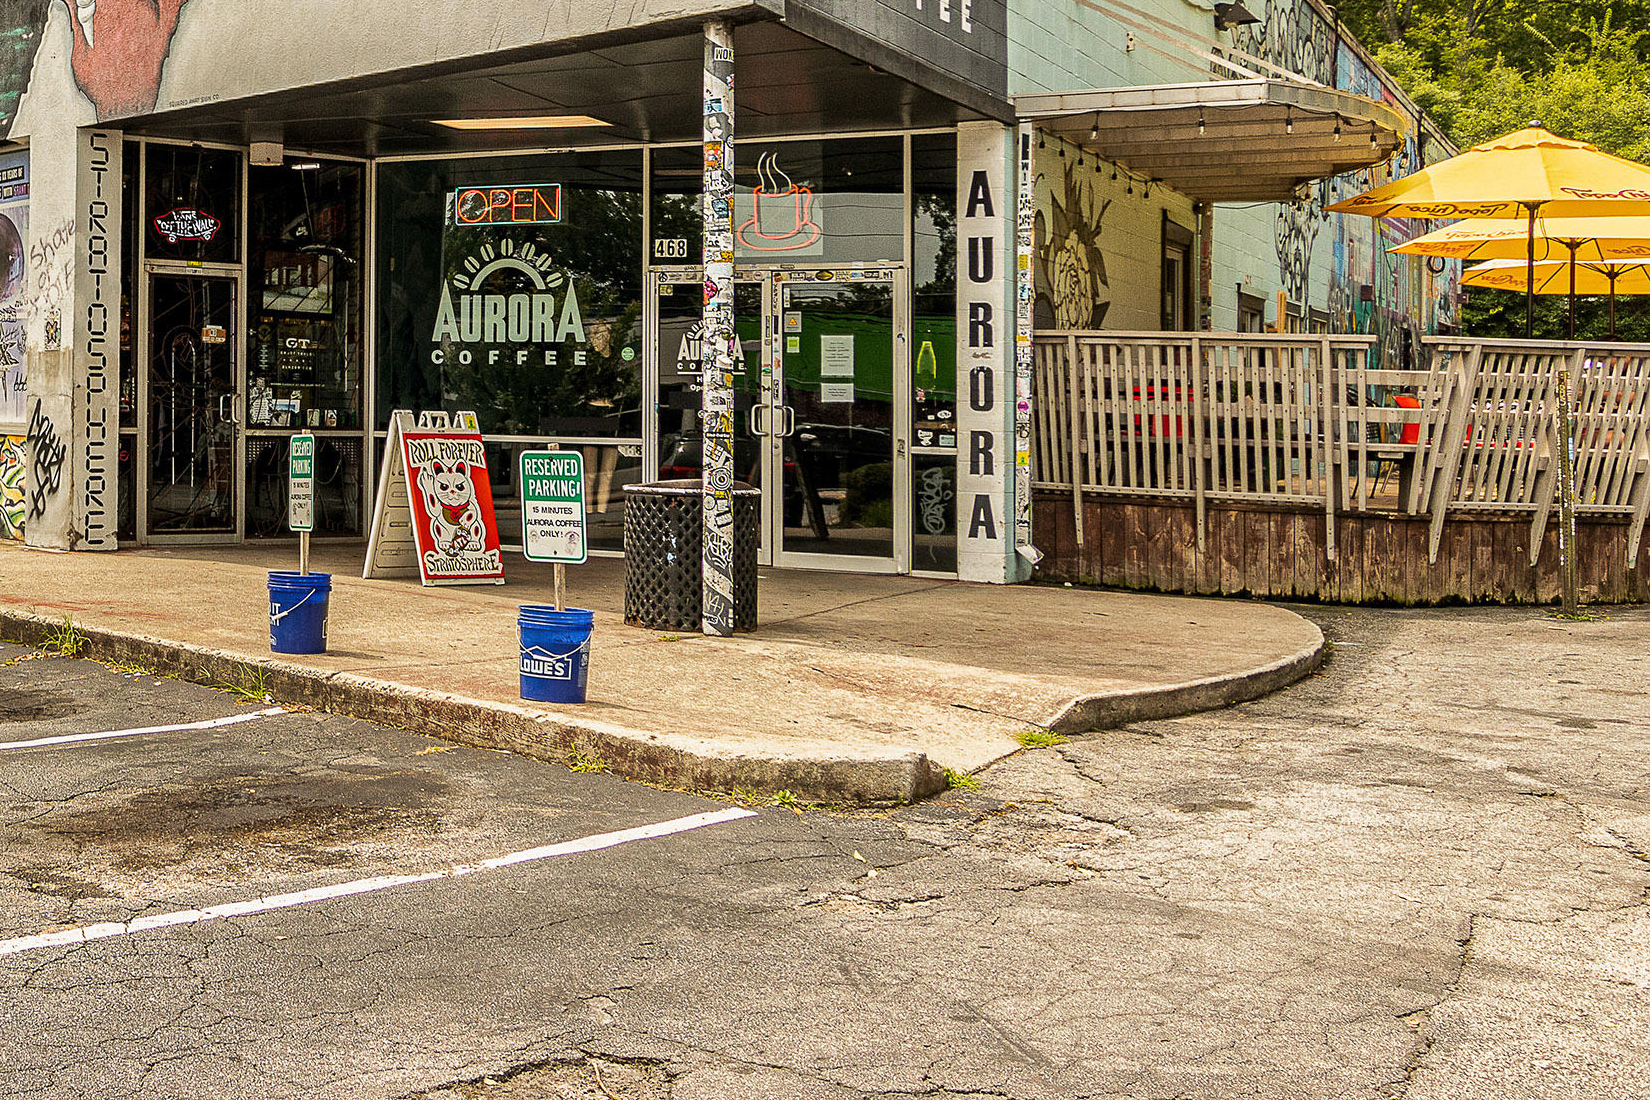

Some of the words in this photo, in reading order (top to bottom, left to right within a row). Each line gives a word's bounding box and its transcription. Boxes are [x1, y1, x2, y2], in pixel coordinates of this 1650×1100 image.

[457, 188, 559, 223] OPEN
[656, 239, 686, 258] 468
[431, 277, 586, 343] AURORA
[84, 132, 109, 546] STRATOSPHERE
[431, 350, 587, 366] COFFEE
[965, 170, 997, 540] AURORA
[292, 441, 312, 456] RESERVED
[409, 441, 438, 464] ROLL
[439, 441, 484, 464] FOREVER
[293, 459, 311, 474] PARKING
[524, 458, 578, 476] RESERVED
[541, 506, 573, 515] MINUTES
[527, 519, 554, 527] AURORA
[426, 553, 500, 572] STRATOSPHERE
[520, 656, 565, 676] LOWE'S
